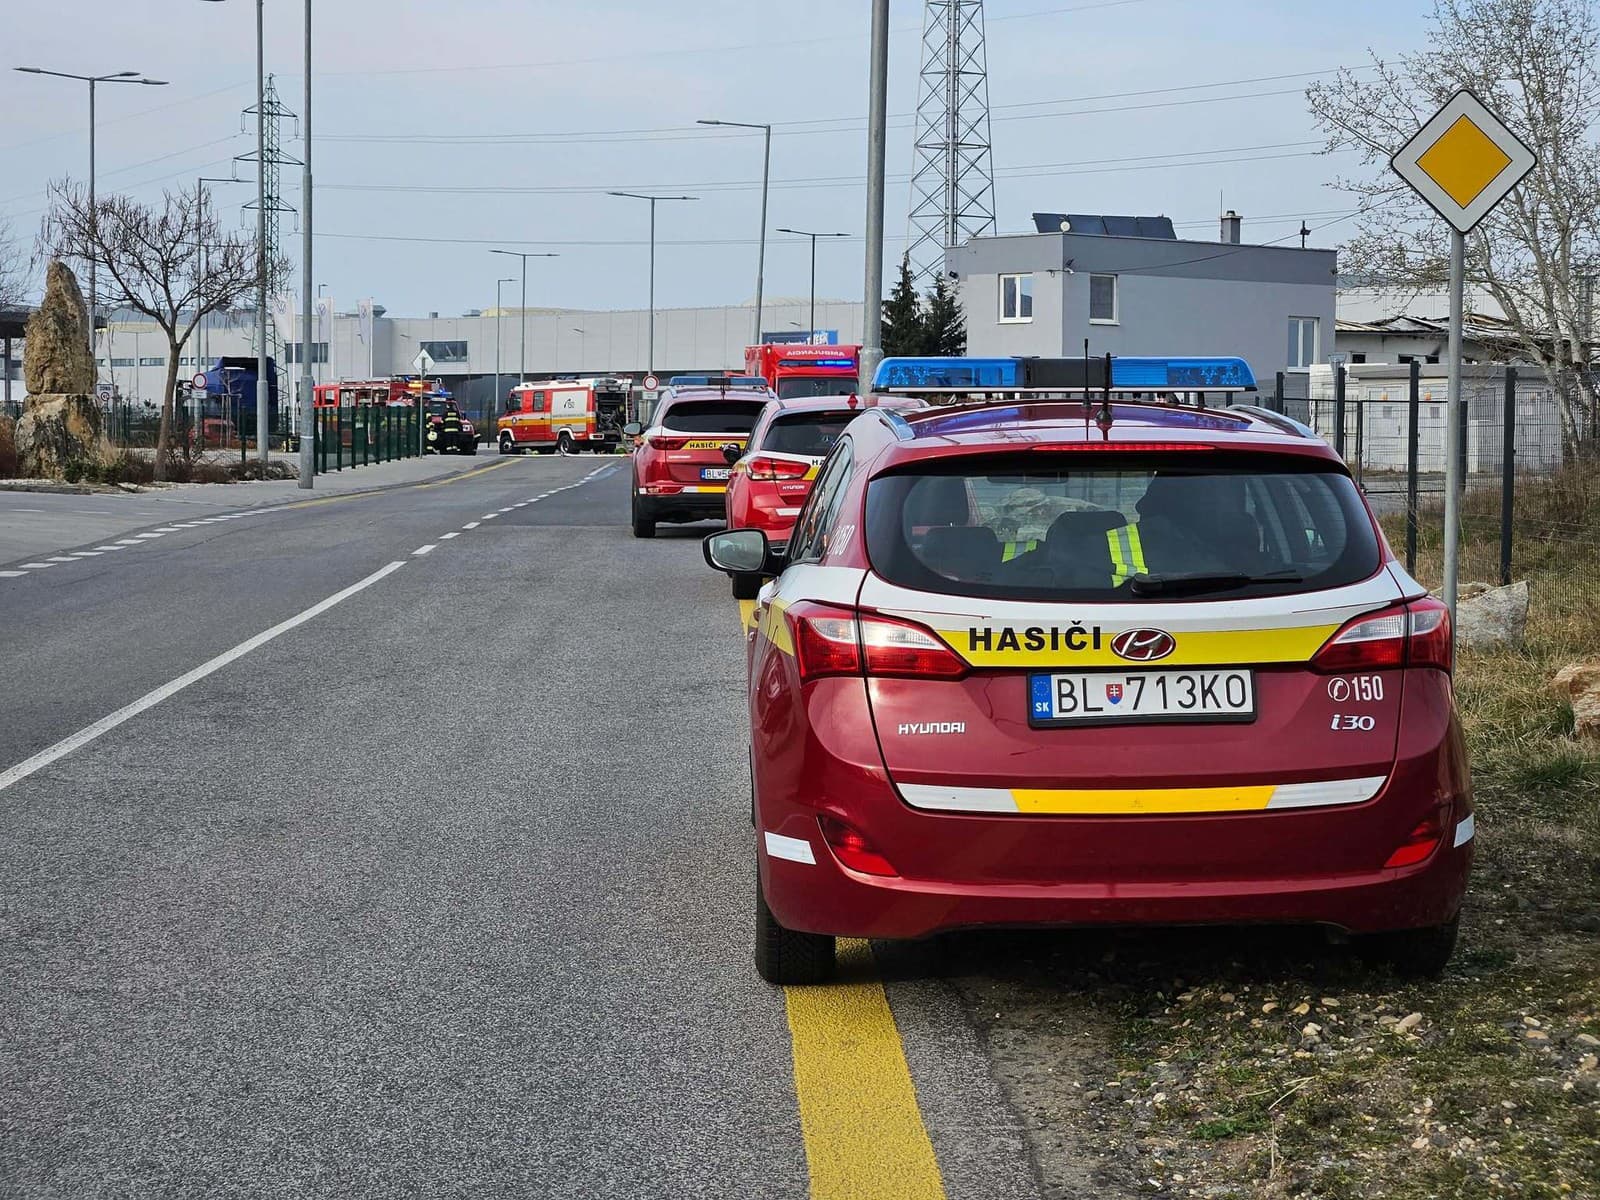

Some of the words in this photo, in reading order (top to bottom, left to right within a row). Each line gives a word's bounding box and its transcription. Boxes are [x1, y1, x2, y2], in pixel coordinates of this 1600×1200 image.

[706, 469, 718, 479] BL
[969, 620, 1101, 651] HASIČI
[1057, 677, 1103, 713] BL
[1351, 675, 1384, 701] 150
[1035, 701, 1050, 712] SK
[898, 722, 965, 735] HYUNDAI
[1331, 714, 1375, 730] i30
